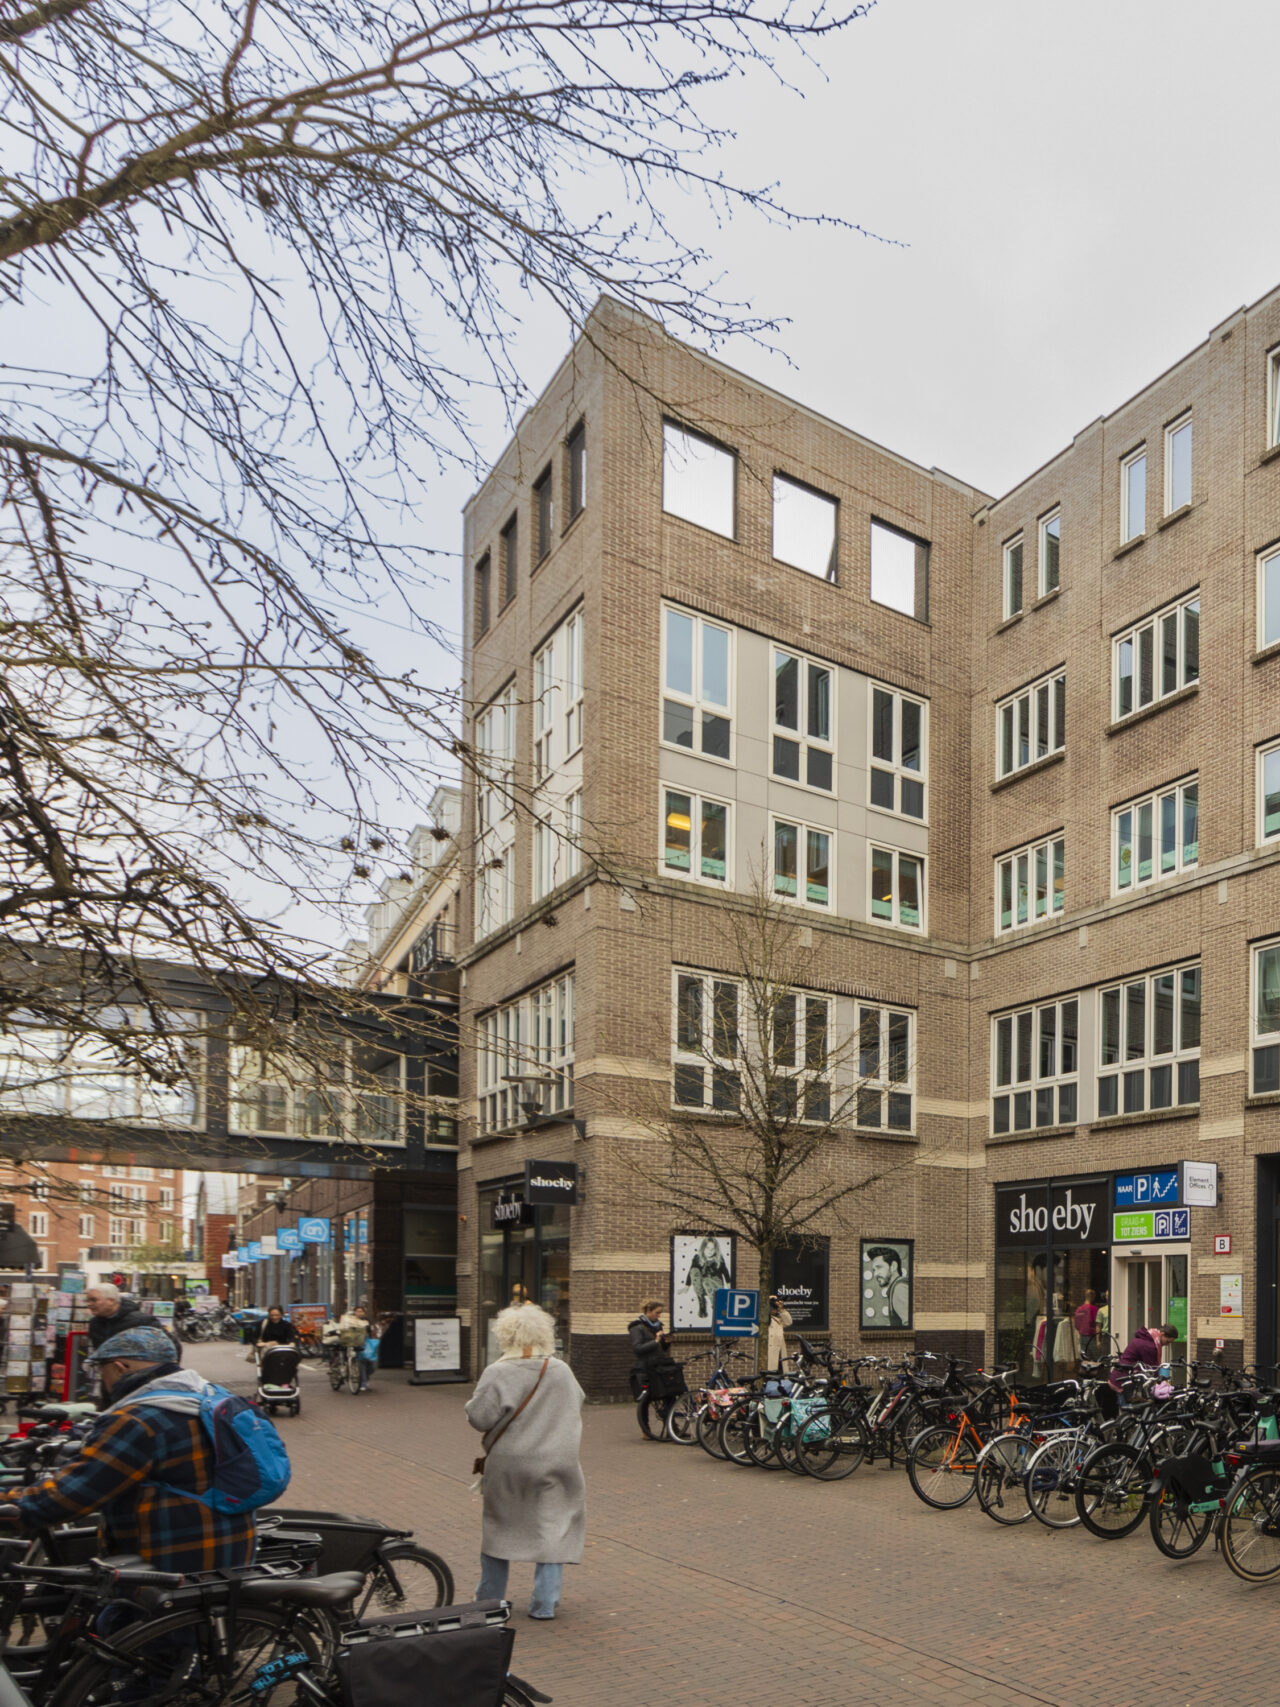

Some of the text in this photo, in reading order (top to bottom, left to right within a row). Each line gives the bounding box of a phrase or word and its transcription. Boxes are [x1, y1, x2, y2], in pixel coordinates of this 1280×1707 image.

[530, 1176, 574, 1190] shoeby
[1117, 1178, 1147, 1200] NAAR P
[1189, 1182, 1207, 1190] Offices
[495, 1191, 522, 1224] shoeby
[1009, 1188, 1097, 1240] shoeby
[1219, 1239, 1226, 1250] B
[777, 1284, 812, 1298] shoeby
[733, 1294, 751, 1316] P
